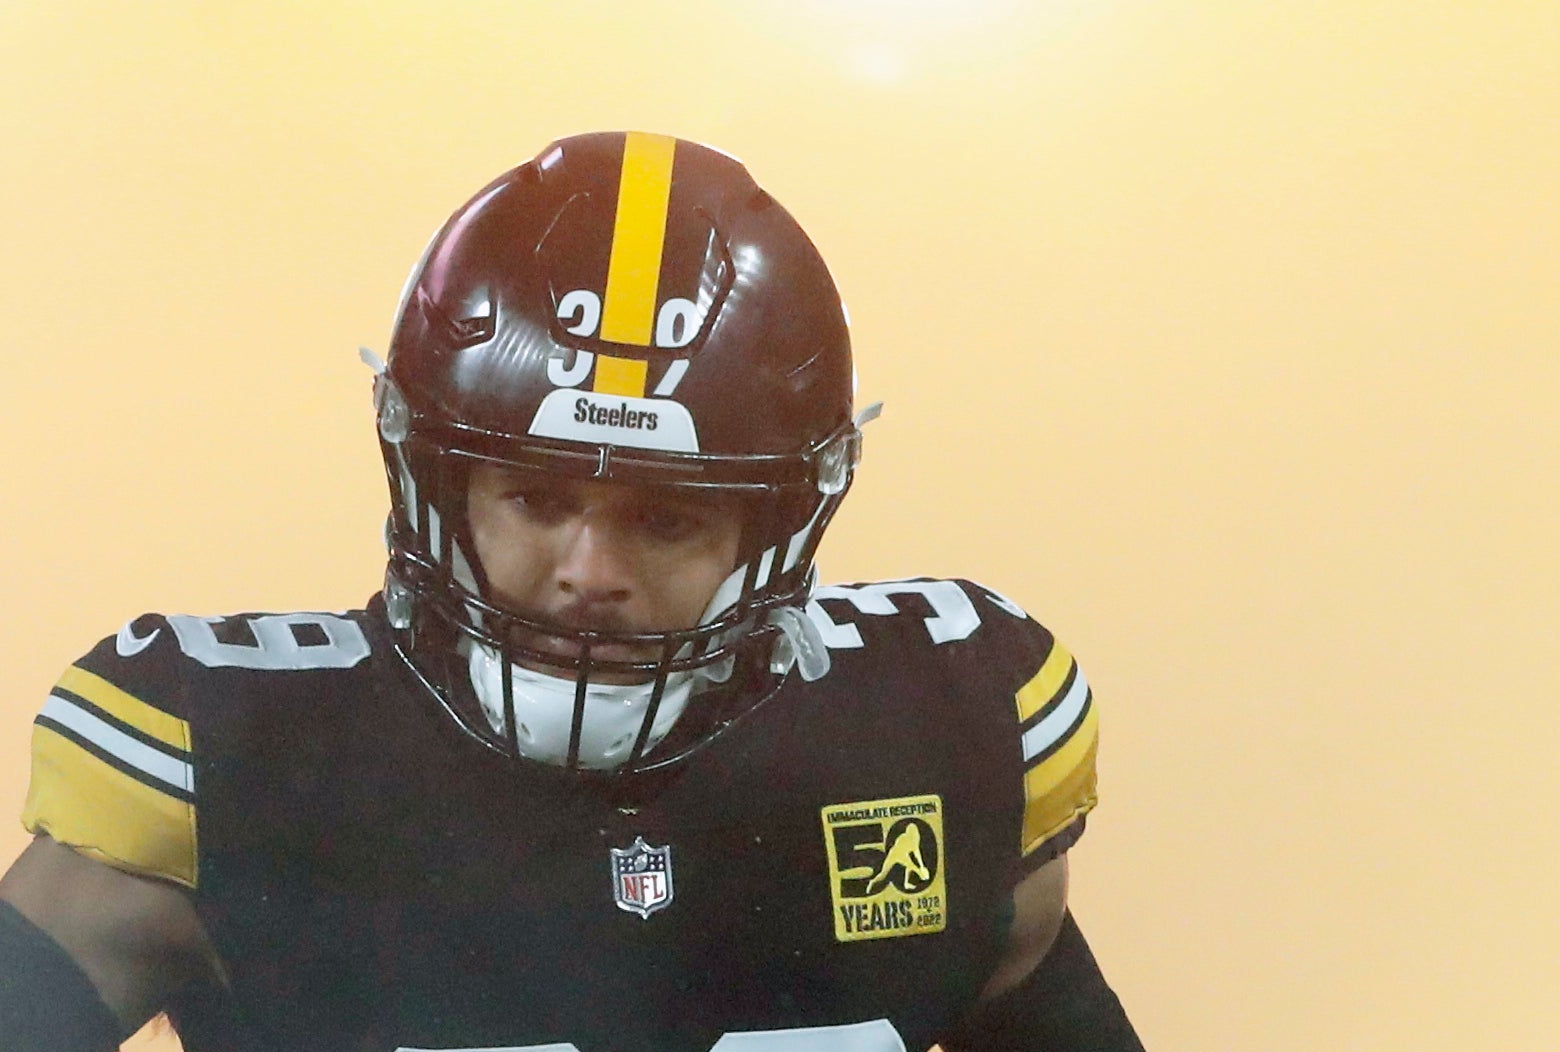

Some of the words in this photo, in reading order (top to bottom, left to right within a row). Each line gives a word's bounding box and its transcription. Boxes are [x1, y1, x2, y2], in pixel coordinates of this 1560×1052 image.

[574, 397, 658, 431] Steelers
[828, 806, 889, 824] IMMACULATE
[890, 802, 936, 817] RECEPTION
[623, 874, 664, 904] NFL
[917, 895, 940, 910] 1972
[840, 901, 913, 932] YEARS
